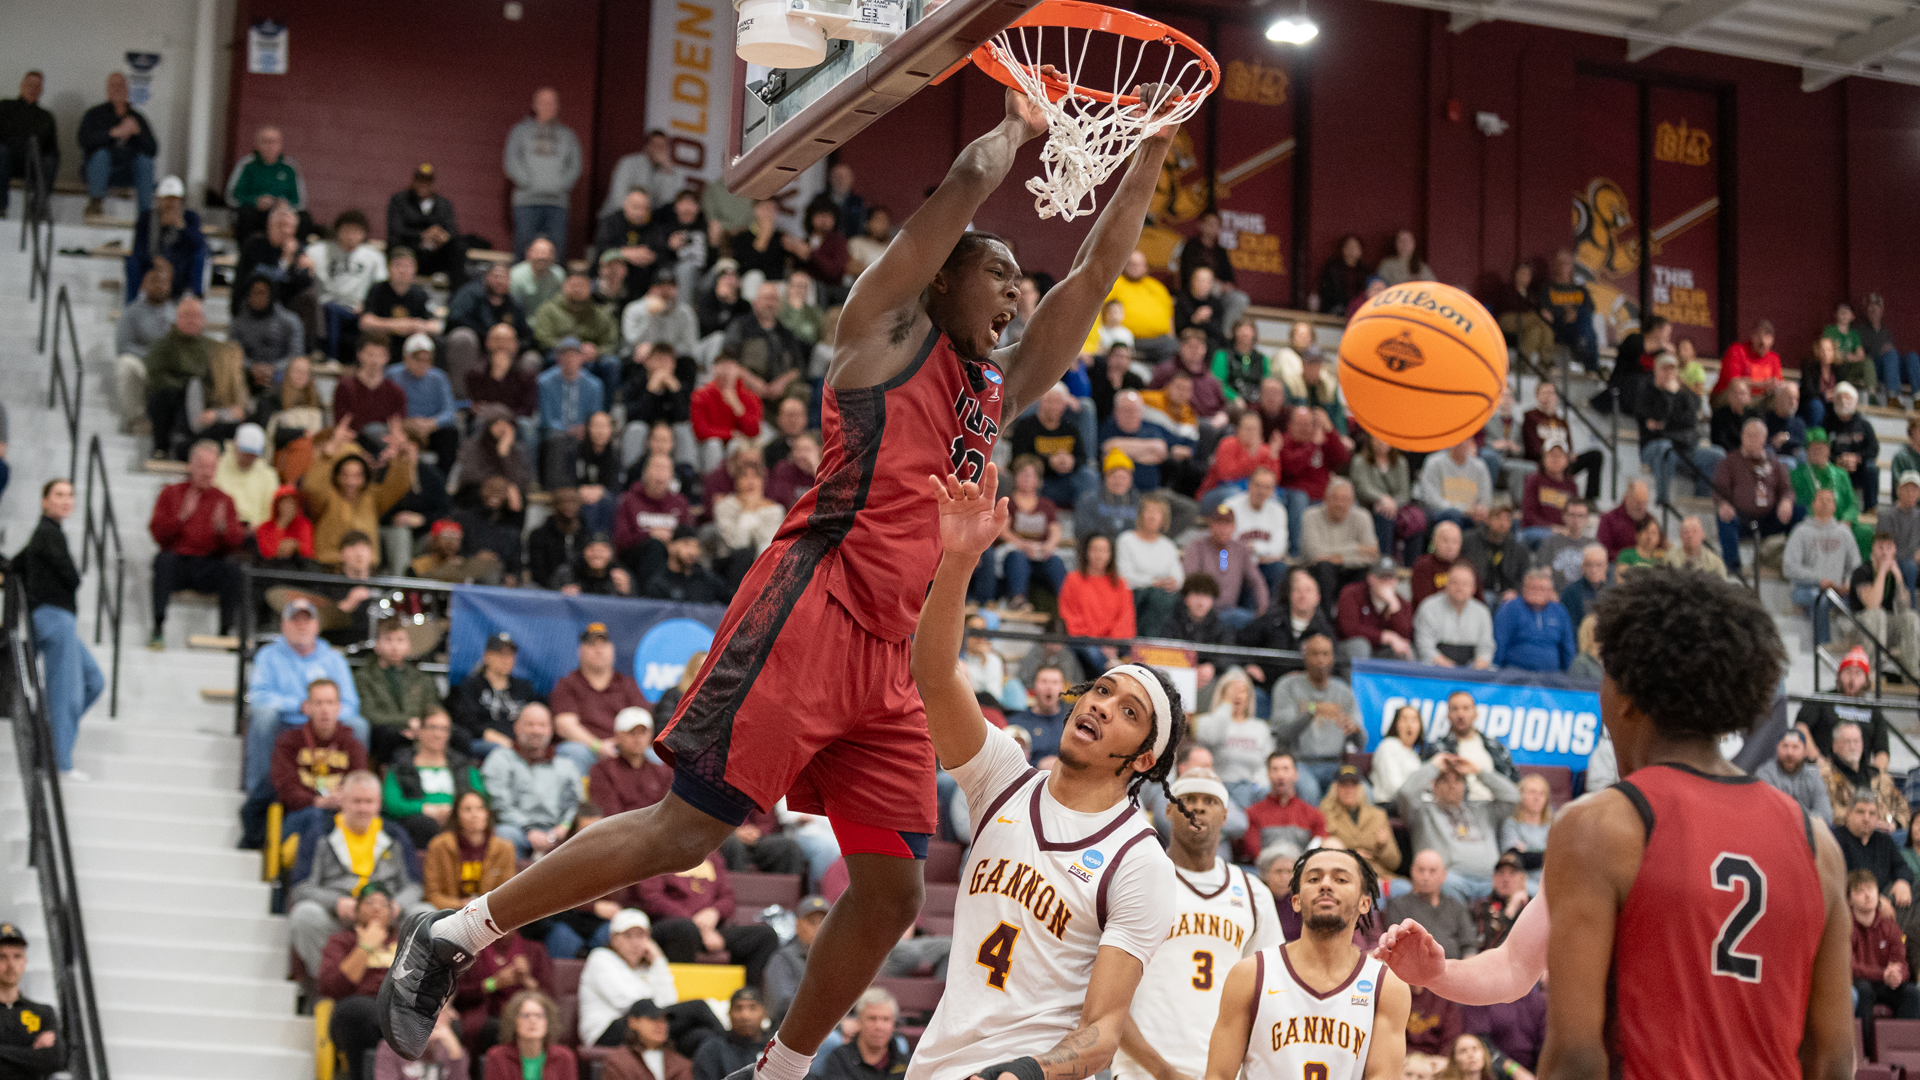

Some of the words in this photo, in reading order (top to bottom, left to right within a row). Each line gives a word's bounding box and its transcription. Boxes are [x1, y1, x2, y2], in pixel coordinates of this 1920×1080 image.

[1652, 264, 1694, 289] THIS
[1652, 284, 1669, 303] IS
[1372, 289, 1474, 335] Wilson
[1069, 864, 1093, 882] PSAC
[969, 858, 1073, 941] GANNON
[1710, 851, 1768, 984] 2
[975, 919, 1022, 993] 4
[1191, 949, 1215, 992] 3
[1271, 1016, 1367, 1061] GANNON
